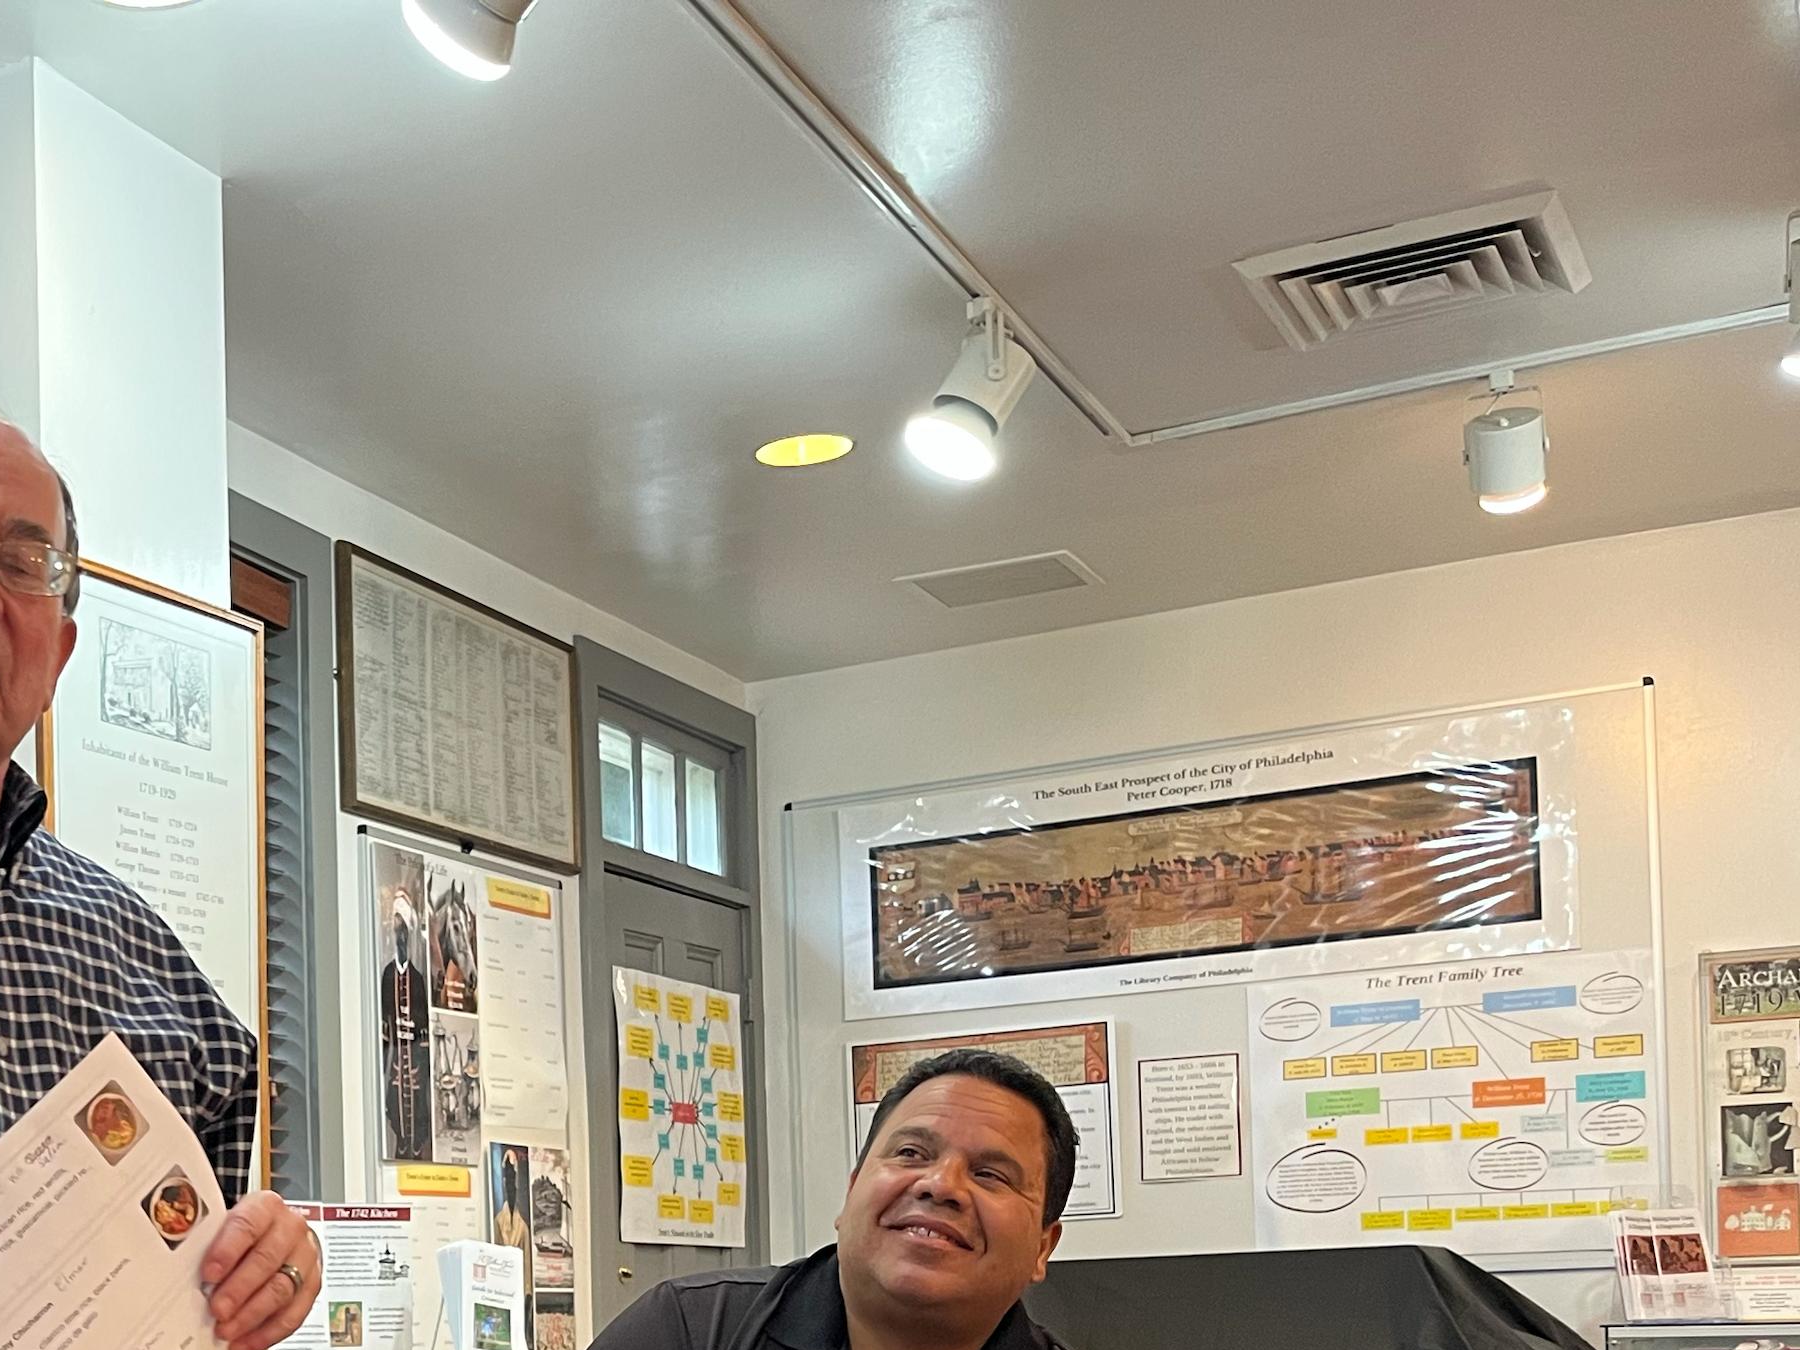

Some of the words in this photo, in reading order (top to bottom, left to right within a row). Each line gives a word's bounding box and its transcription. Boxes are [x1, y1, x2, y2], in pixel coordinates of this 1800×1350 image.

[82, 738, 126, 760] Inhabitants
[129, 753, 136, 762] of
[139, 754, 149, 766] the
[153, 758, 181, 774] William
[184, 766, 204, 780] Trent
[207, 771, 228, 786] House
[1033, 790, 1054, 801] The
[1058, 784, 1092, 797] South
[1095, 780, 1118, 792] East
[1121, 774, 1170, 788] Prospect
[1174, 769, 1186, 780] of
[1190, 767, 1208, 777] the
[1211, 763, 1237, 777] City
[1239, 759, 1252, 771] of
[1255, 750, 1334, 769] Philadelphia
[1127, 789, 1156, 801] Peter
[1159, 783, 1207, 798] Cooper,
[1210, 778, 1232, 790] 1718
[1208, 968, 1252, 976] Philadelphia
[1366, 977, 1395, 989] The
[1398, 973, 1433, 987] Trent
[1437, 968, 1489, 985] Family
[1492, 965, 1523, 978] Tree
[1719, 969, 1800, 989] ARCHA
[1720, 989, 1783, 1015] 1719
[336, 1209, 348, 1218] The
[351, 1208, 369, 1218] 1742
[371, 1208, 398, 1218] Kitchen
